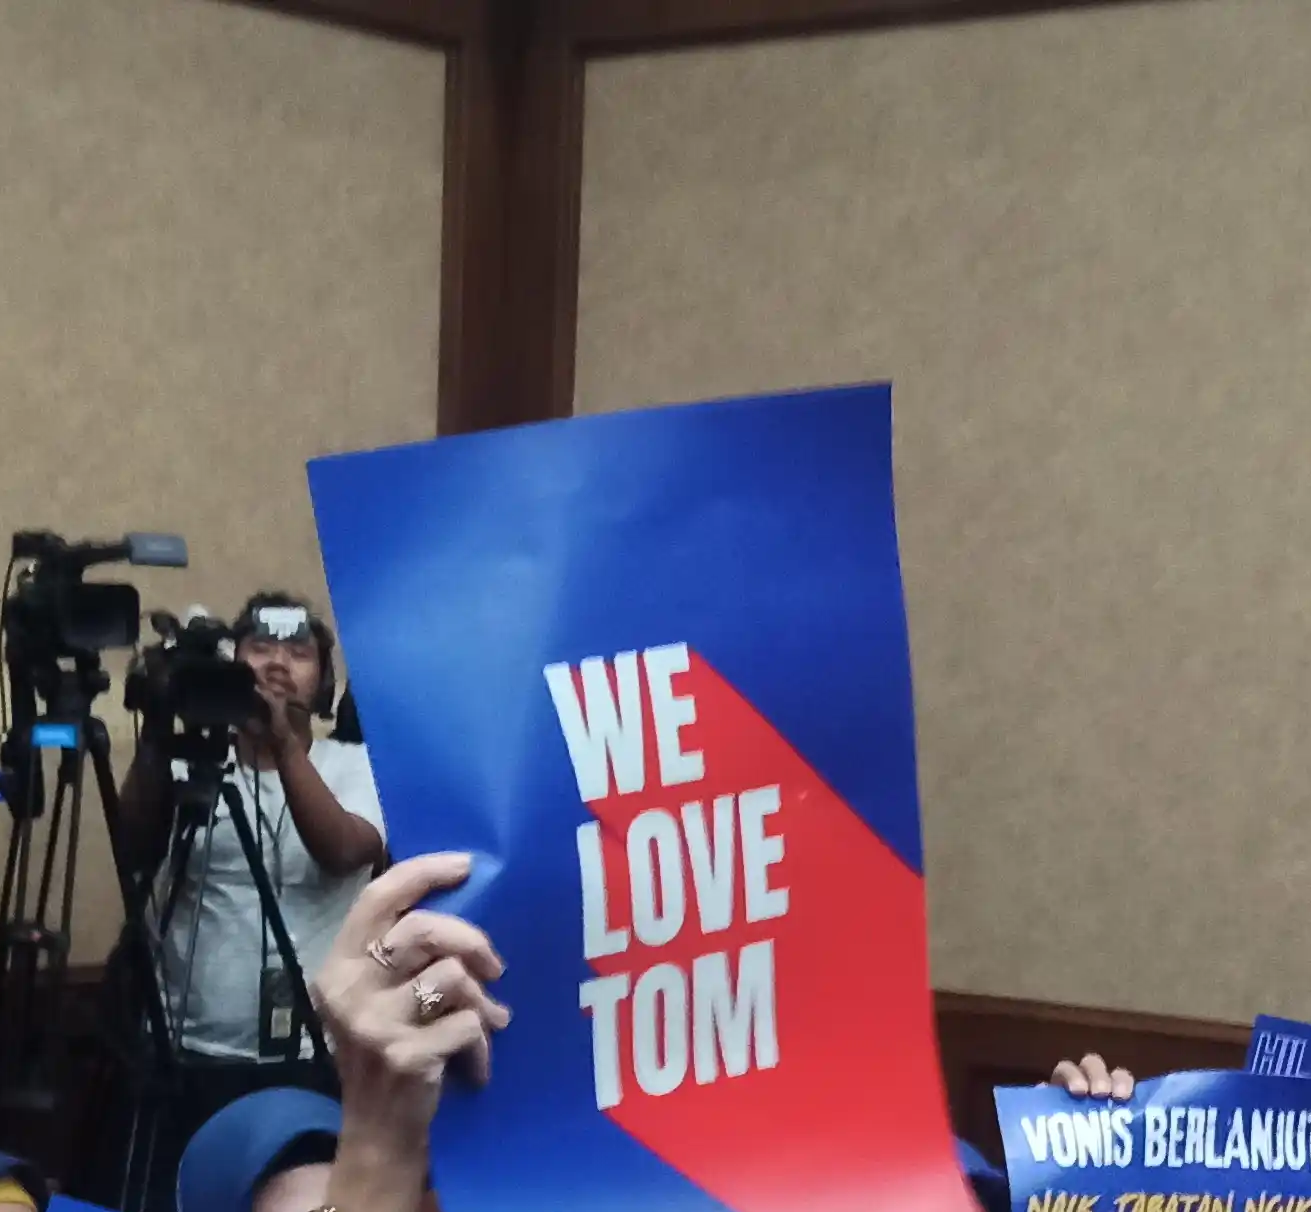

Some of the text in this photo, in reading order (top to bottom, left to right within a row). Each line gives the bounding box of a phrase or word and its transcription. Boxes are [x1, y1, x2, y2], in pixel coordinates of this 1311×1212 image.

[543, 641, 705, 802] WE
[576, 783, 789, 960] LOVE
[579, 938, 779, 1111] TOM
[1021, 1106, 1134, 1168] VONIS
